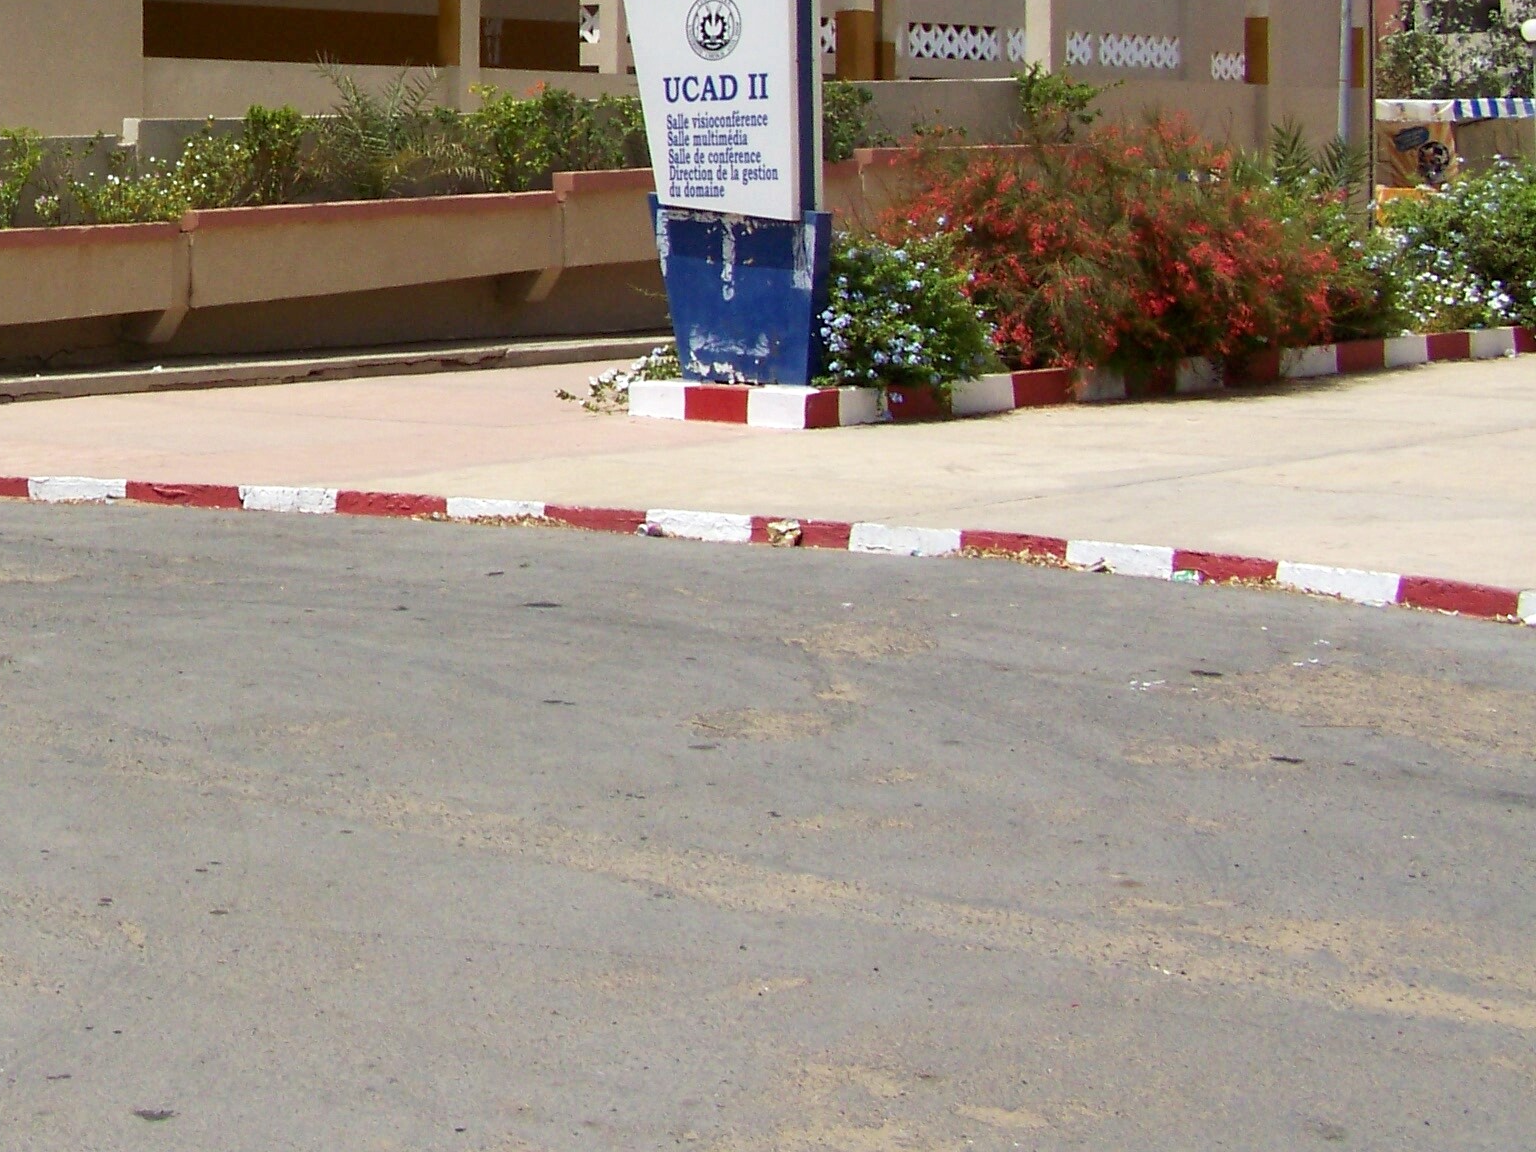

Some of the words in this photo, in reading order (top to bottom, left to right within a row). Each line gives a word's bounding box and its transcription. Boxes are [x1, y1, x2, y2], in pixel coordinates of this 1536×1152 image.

[663, 75, 738, 103] UCAD
[748, 73, 768, 99] II
[667, 113, 689, 130] Salle
[692, 111, 768, 129] visioconférence
[668, 131, 689, 146] Salle
[693, 129, 748, 146] multimédia
[669, 148, 690, 164] Salle
[694, 148, 704, 163] de
[708, 147, 761, 163] conférence
[669, 165, 713, 181] Direction
[717, 164, 727, 180] de
[731, 164, 739, 180] la
[742, 164, 778, 185] gestion
[670, 182, 681, 197] du
[684, 182, 725, 197] domaine
